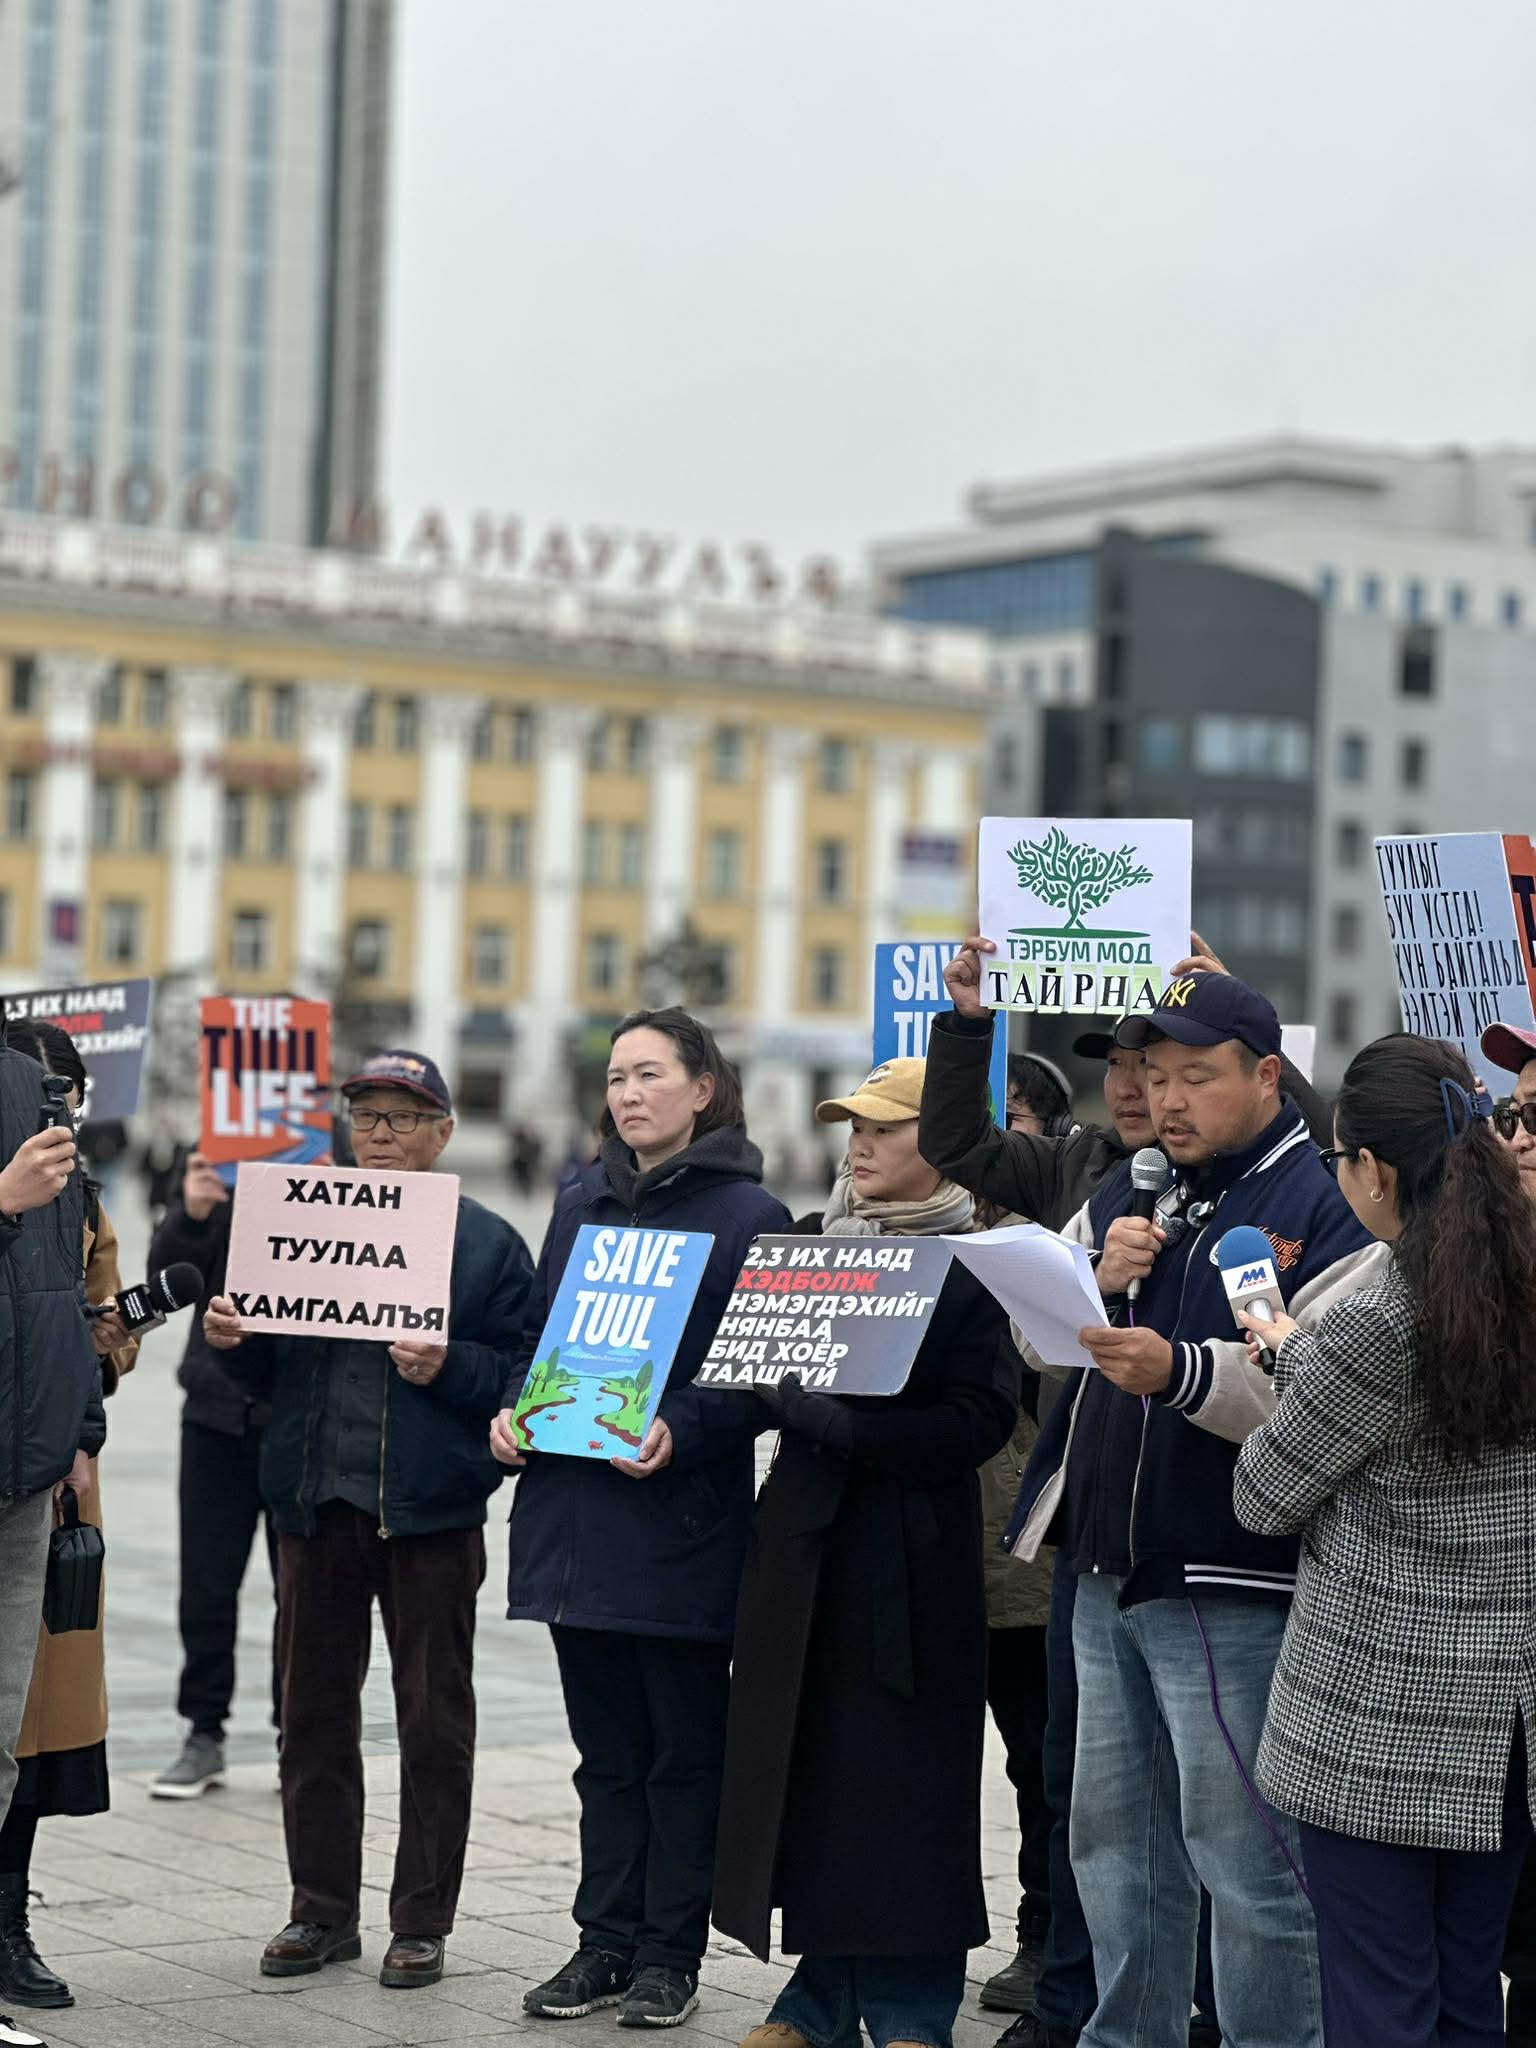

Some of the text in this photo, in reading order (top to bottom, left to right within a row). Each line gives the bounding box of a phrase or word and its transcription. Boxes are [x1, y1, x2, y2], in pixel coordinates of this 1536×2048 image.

[1006, 938, 1152, 964] ТЭРБУМ МОД
[893, 945, 962, 1001] SAV
[988, 967, 1158, 1009] ТАЙРНА
[231, 998, 293, 1040] THE
[213, 1069, 317, 1139] LIFE
[284, 1178, 402, 1209] ХАТАН
[268, 1236, 407, 1269] ТУУЛАА
[584, 1229, 687, 1288] SAVE
[743, 1247, 914, 1271] 2,3 ИХ НАЯД
[735, 1270, 881, 1294] ХЭДБОЛЖ
[229, 1292, 444, 1331] ХАМГААЛЪЯ
[566, 1290, 656, 1350] TUUL
[726, 1292, 935, 1318] НЭМЭГДЭХИЙГ
[716, 1316, 832, 1338] НЯНБАА
[707, 1337, 849, 1364] БИД ХОЁР
